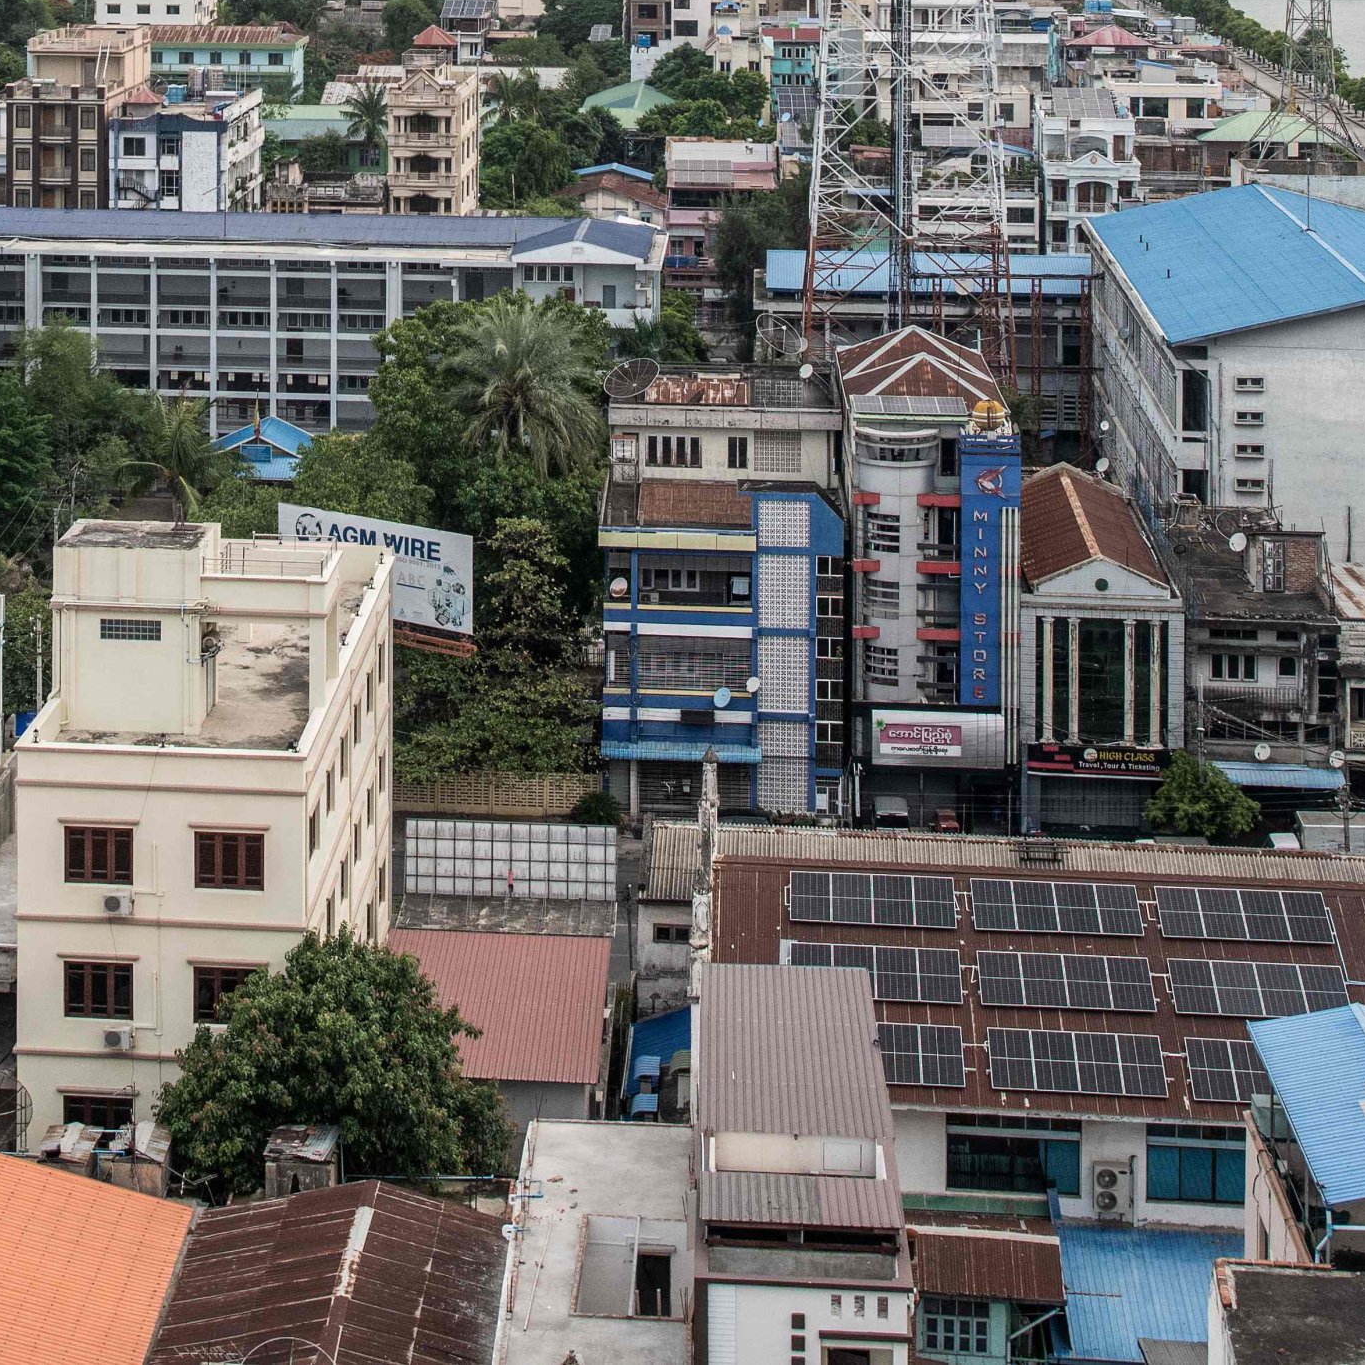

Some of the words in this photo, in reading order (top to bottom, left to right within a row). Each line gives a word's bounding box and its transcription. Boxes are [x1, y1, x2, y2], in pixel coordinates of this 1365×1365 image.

[327, 523, 377, 546] AGM
[383, 532, 441, 561] WIRE
[973, 511, 987, 594] MINNY
[972, 613, 986, 699] STORE
[1099, 751, 1123, 761] HIGH
[1124, 752, 1155, 762] CLASS
